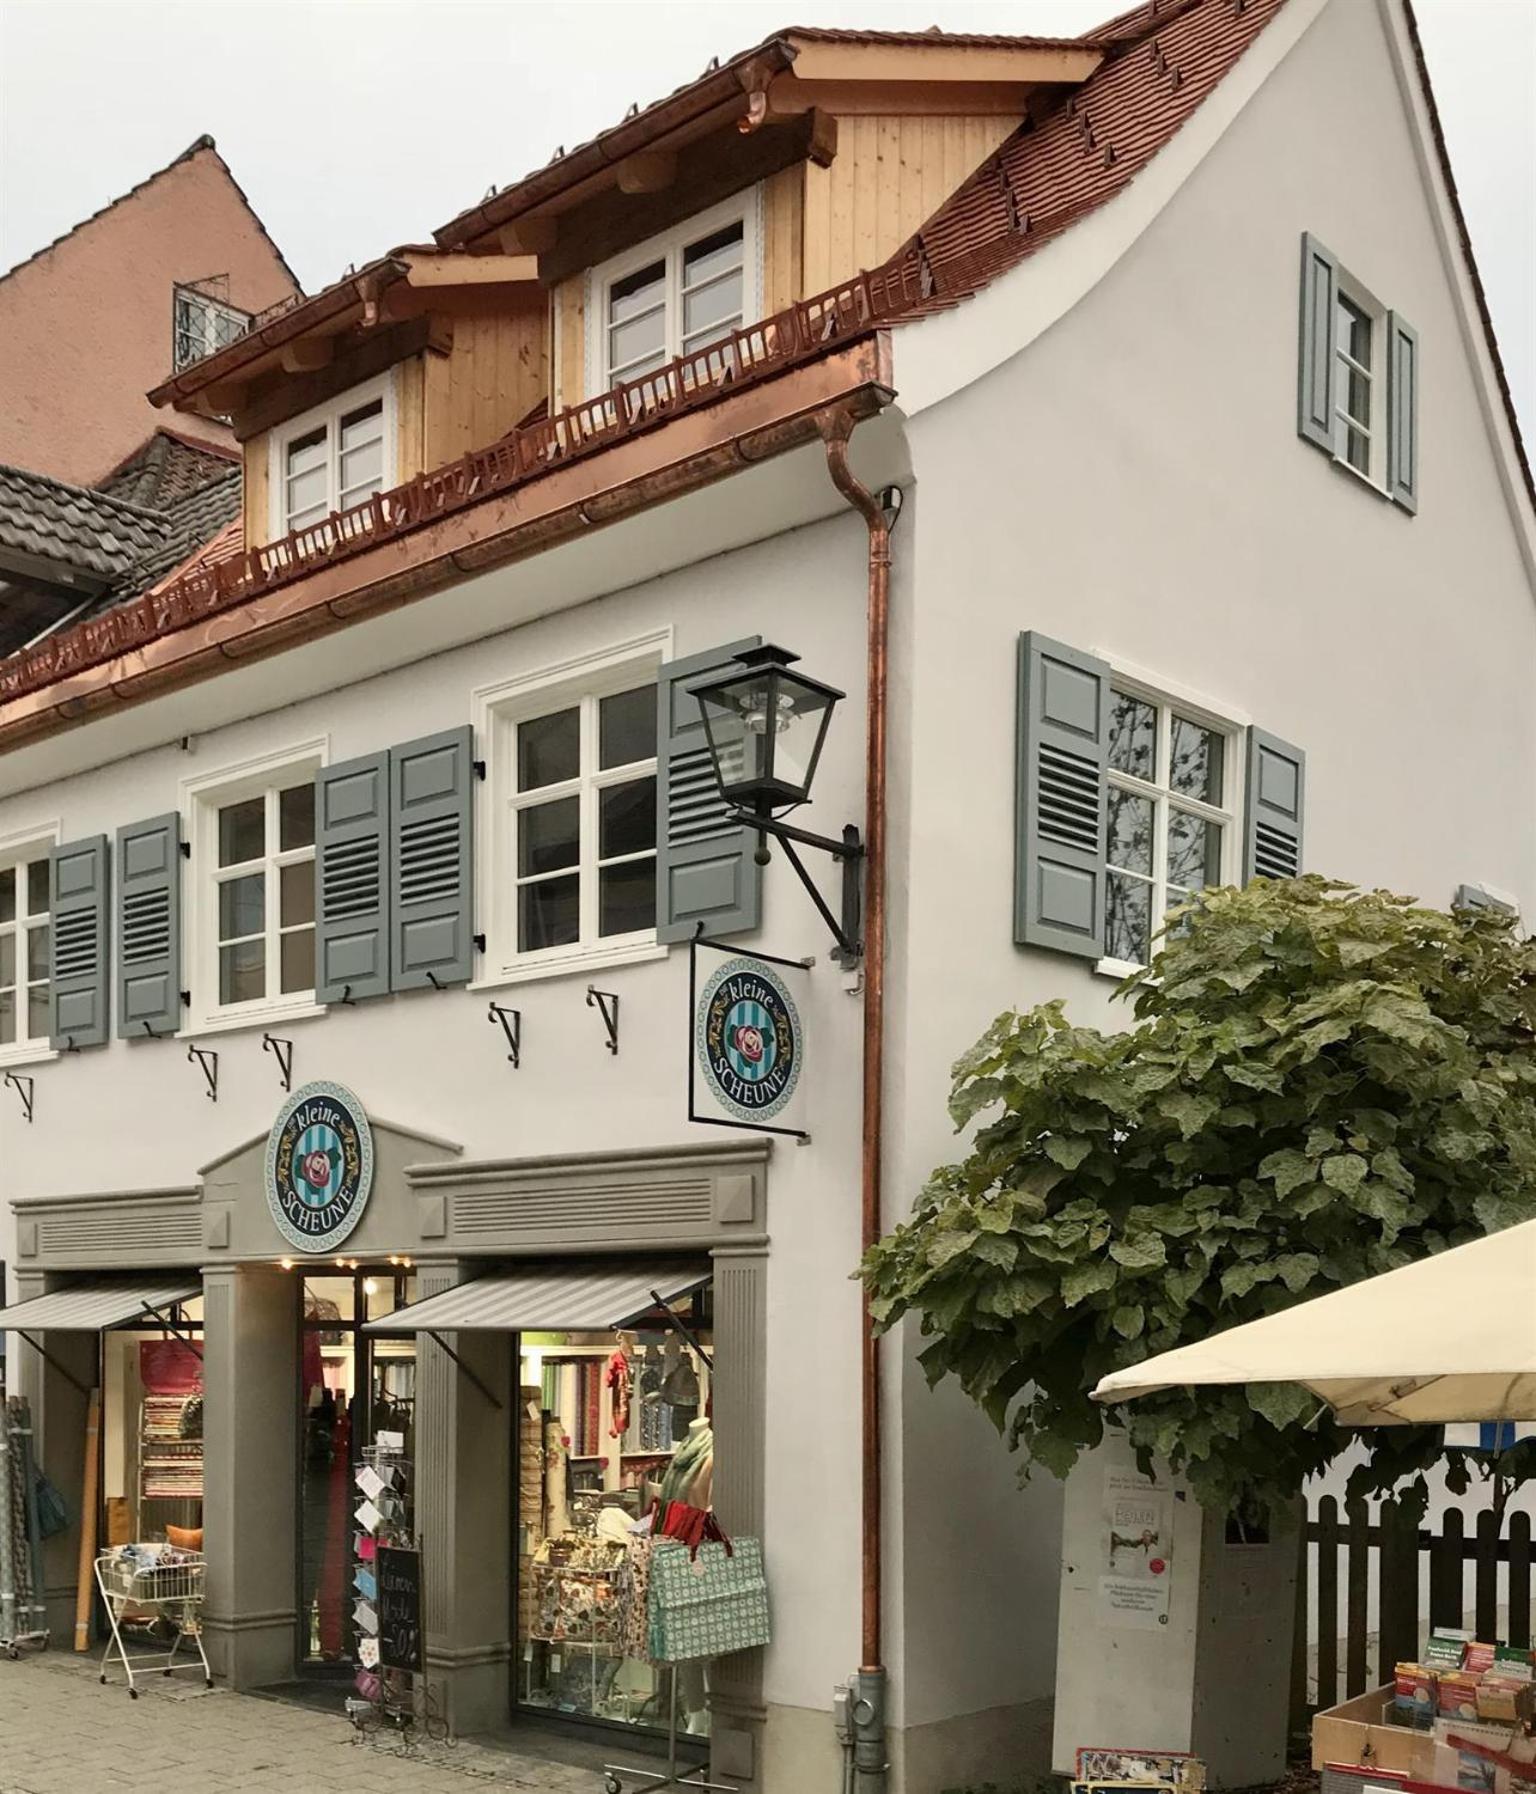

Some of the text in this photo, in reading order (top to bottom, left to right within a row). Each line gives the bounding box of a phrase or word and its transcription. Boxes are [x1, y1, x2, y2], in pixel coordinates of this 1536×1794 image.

[728, 978, 774, 1008] kleine
[713, 1057, 786, 1105] SCHEUNE
[295, 1101, 341, 1132] kleine
[282, 1186, 354, 1233] SCHEUNE
